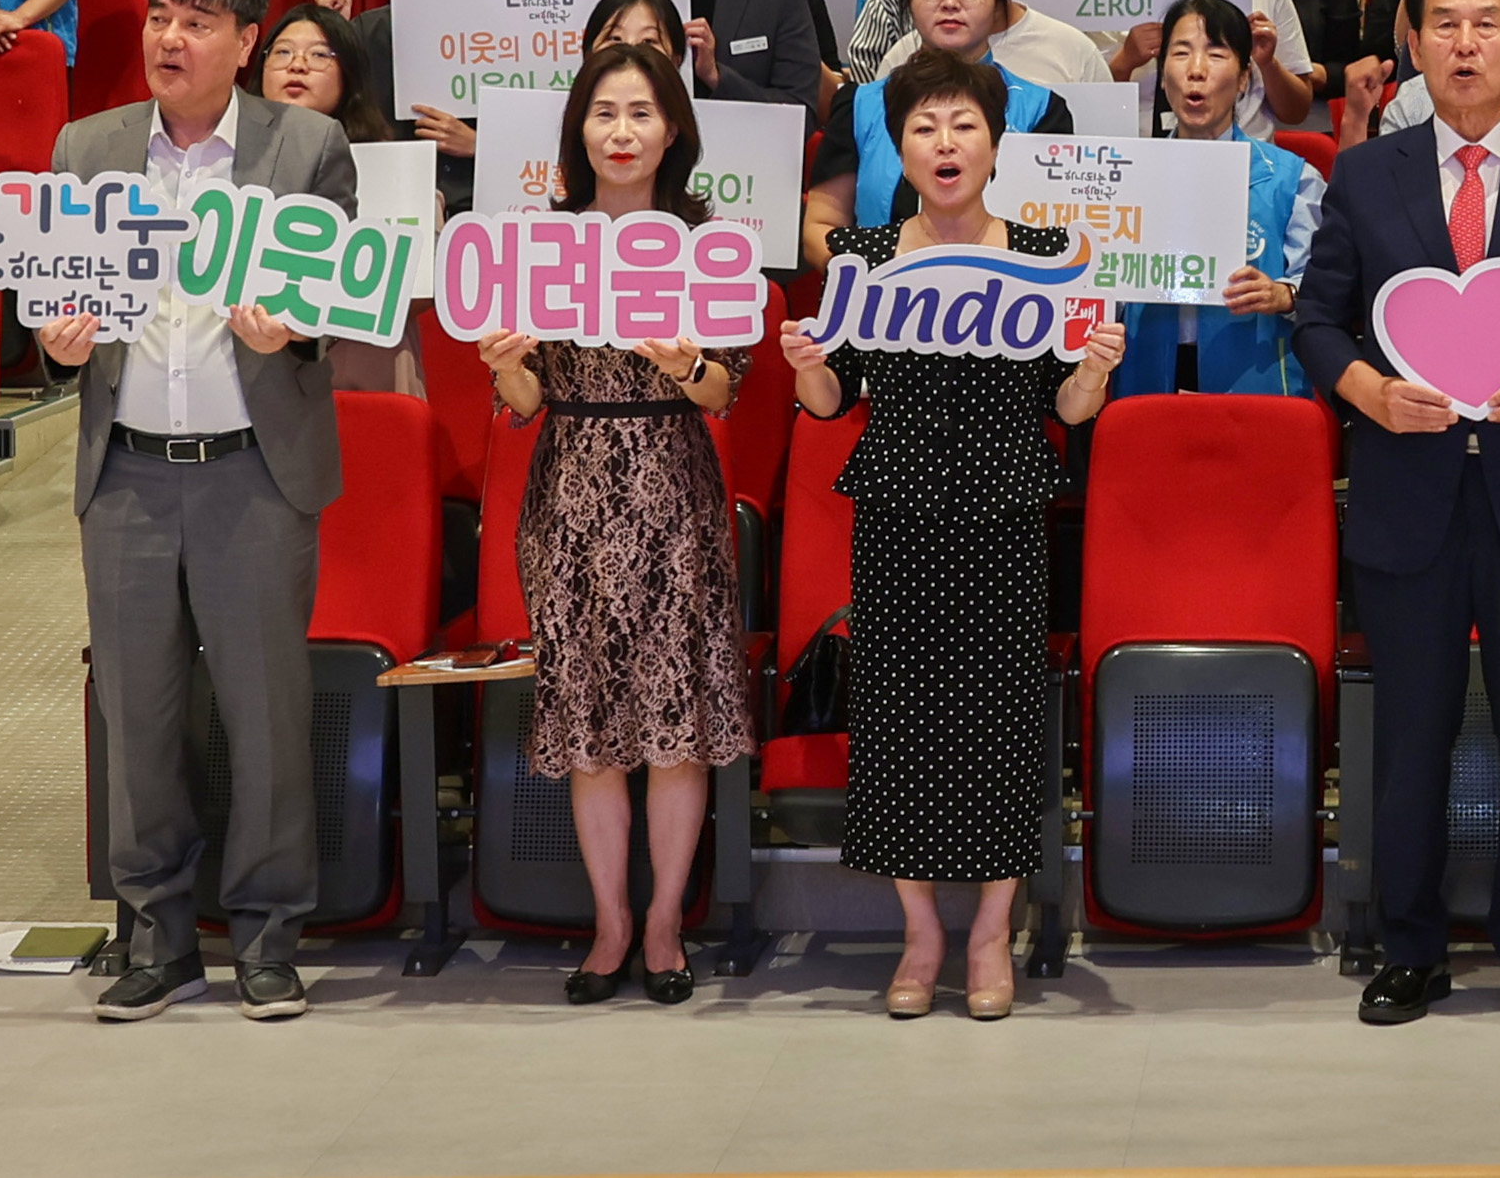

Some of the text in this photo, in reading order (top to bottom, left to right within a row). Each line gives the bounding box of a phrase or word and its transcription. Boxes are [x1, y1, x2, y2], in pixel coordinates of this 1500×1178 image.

[440, 33, 519, 65] 이웃의
[8, 251, 120, 290] 하나되는
[178, 189, 412, 338] 이웃의
[444, 220, 758, 341] 어려움은
[1093, 251, 1216, 289] 함께해요!
[28, 290, 148, 332] 대한민국
[804, 264, 1054, 350] Jindo
